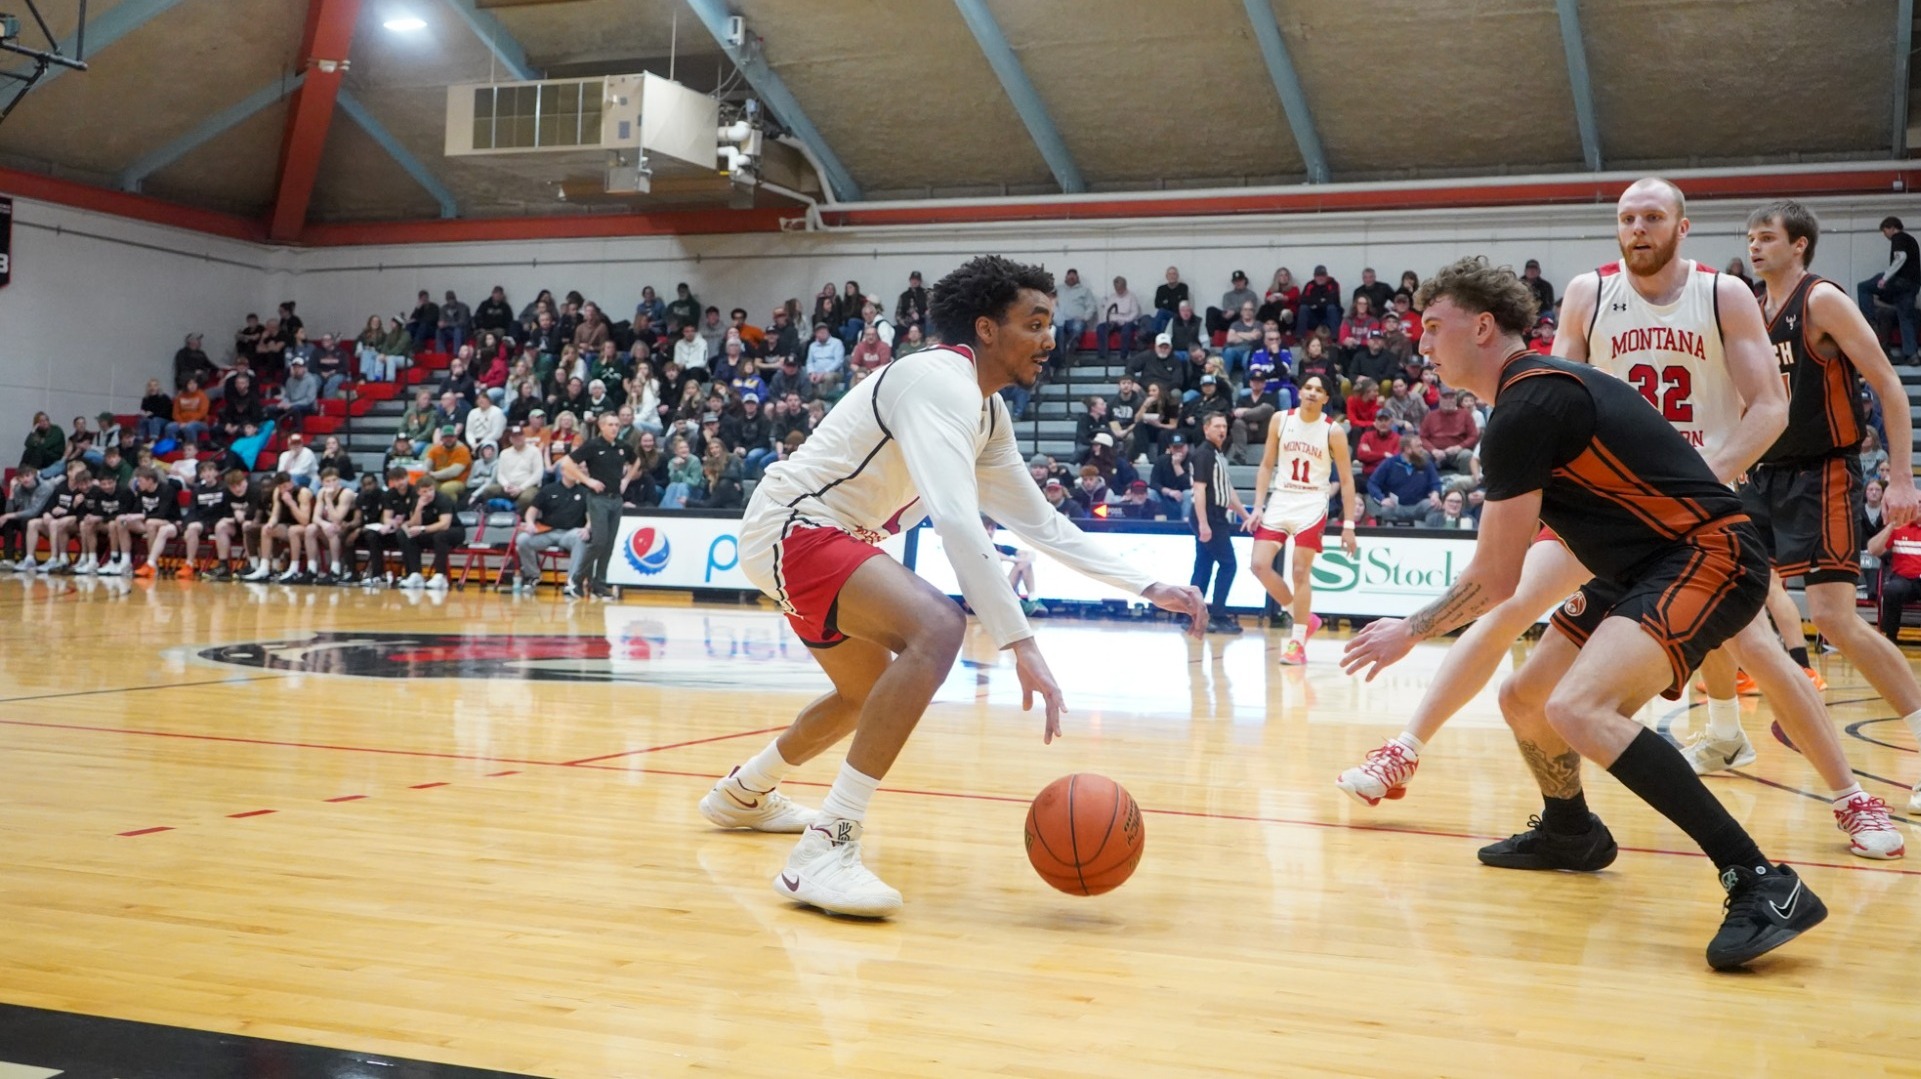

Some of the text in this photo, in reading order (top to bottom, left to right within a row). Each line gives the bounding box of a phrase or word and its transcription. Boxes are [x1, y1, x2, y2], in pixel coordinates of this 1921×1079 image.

[1611, 327, 1706, 361] MONTANA
[1628, 363, 1693, 423] 32
[1283, 441, 1323, 460] MONTANA
[1291, 457, 1310, 484] 11
[705, 534, 739, 583] p
